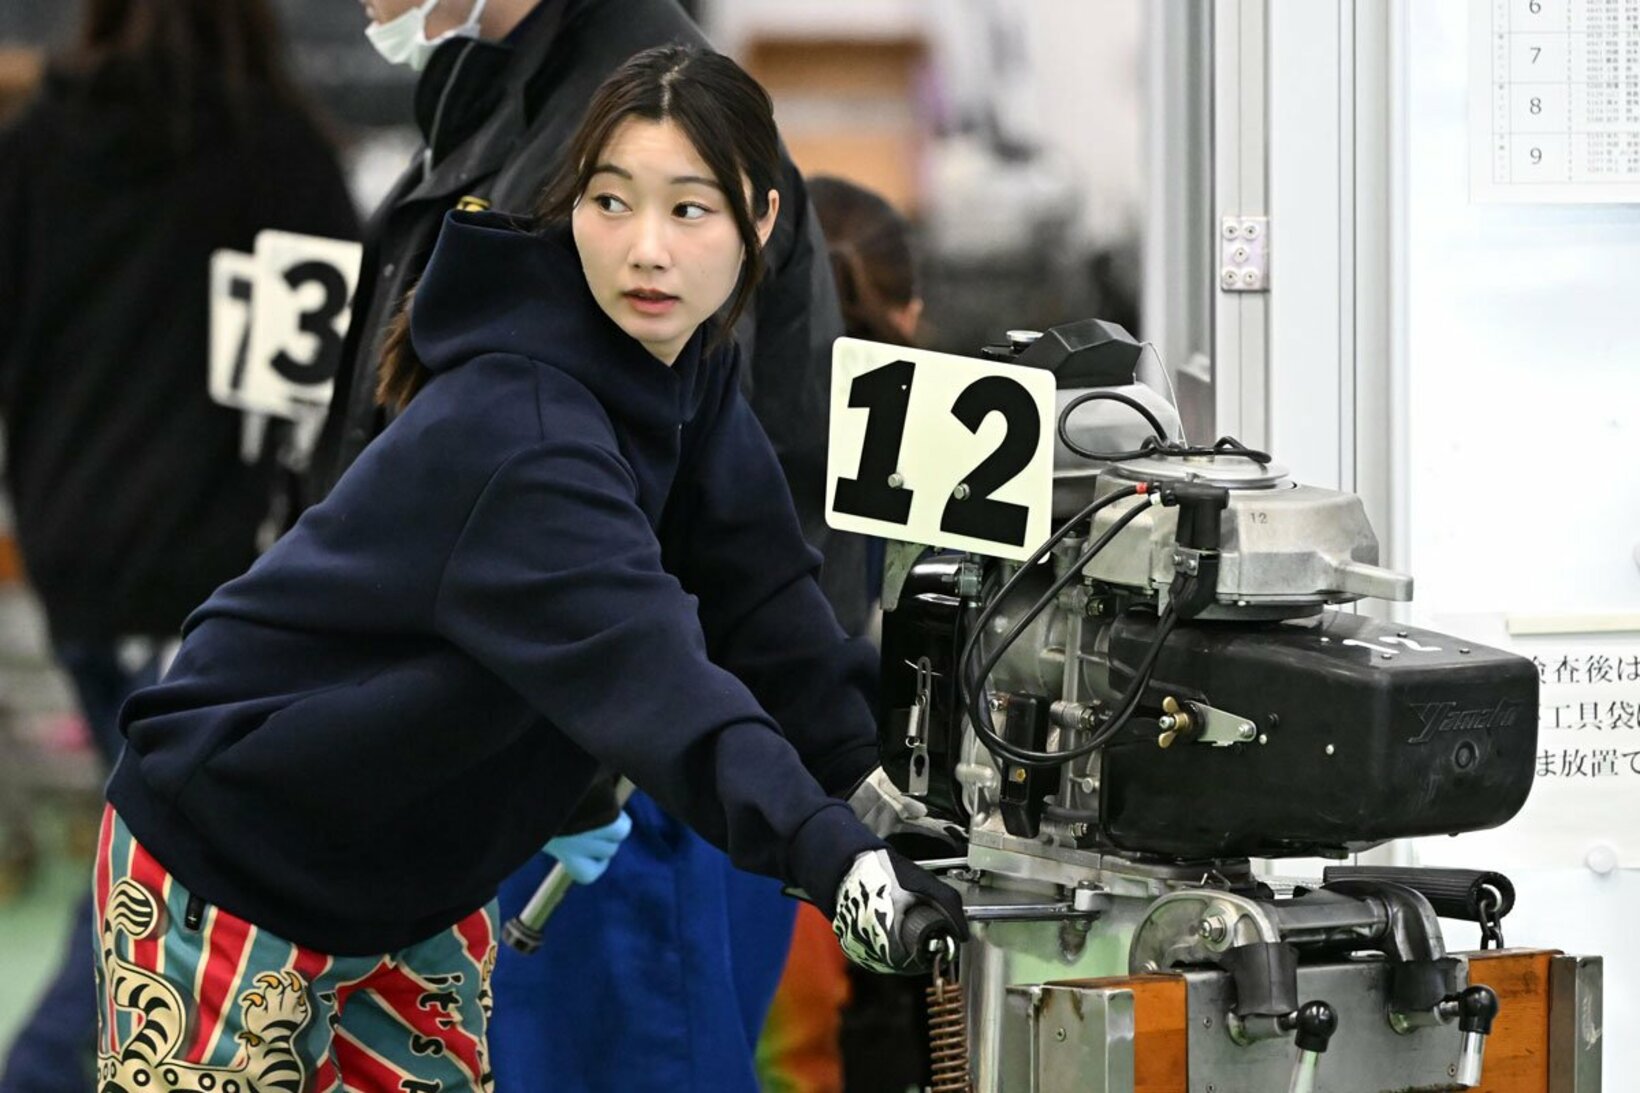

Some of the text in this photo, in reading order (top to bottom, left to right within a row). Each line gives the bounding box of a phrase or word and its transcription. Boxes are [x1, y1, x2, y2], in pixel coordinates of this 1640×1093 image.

[1529, 0, 1542, 14] 6
[1530, 47, 1542, 65] 7
[1530, 97, 1542, 115] 8
[1530, 147, 1543, 165] 9
[270, 260, 348, 385] 3
[832, 359, 1041, 547] 12
[1250, 512, 1268, 524] 12
[1342, 636, 1443, 654] 12
[1539, 701, 1640, 731] 工具袋
